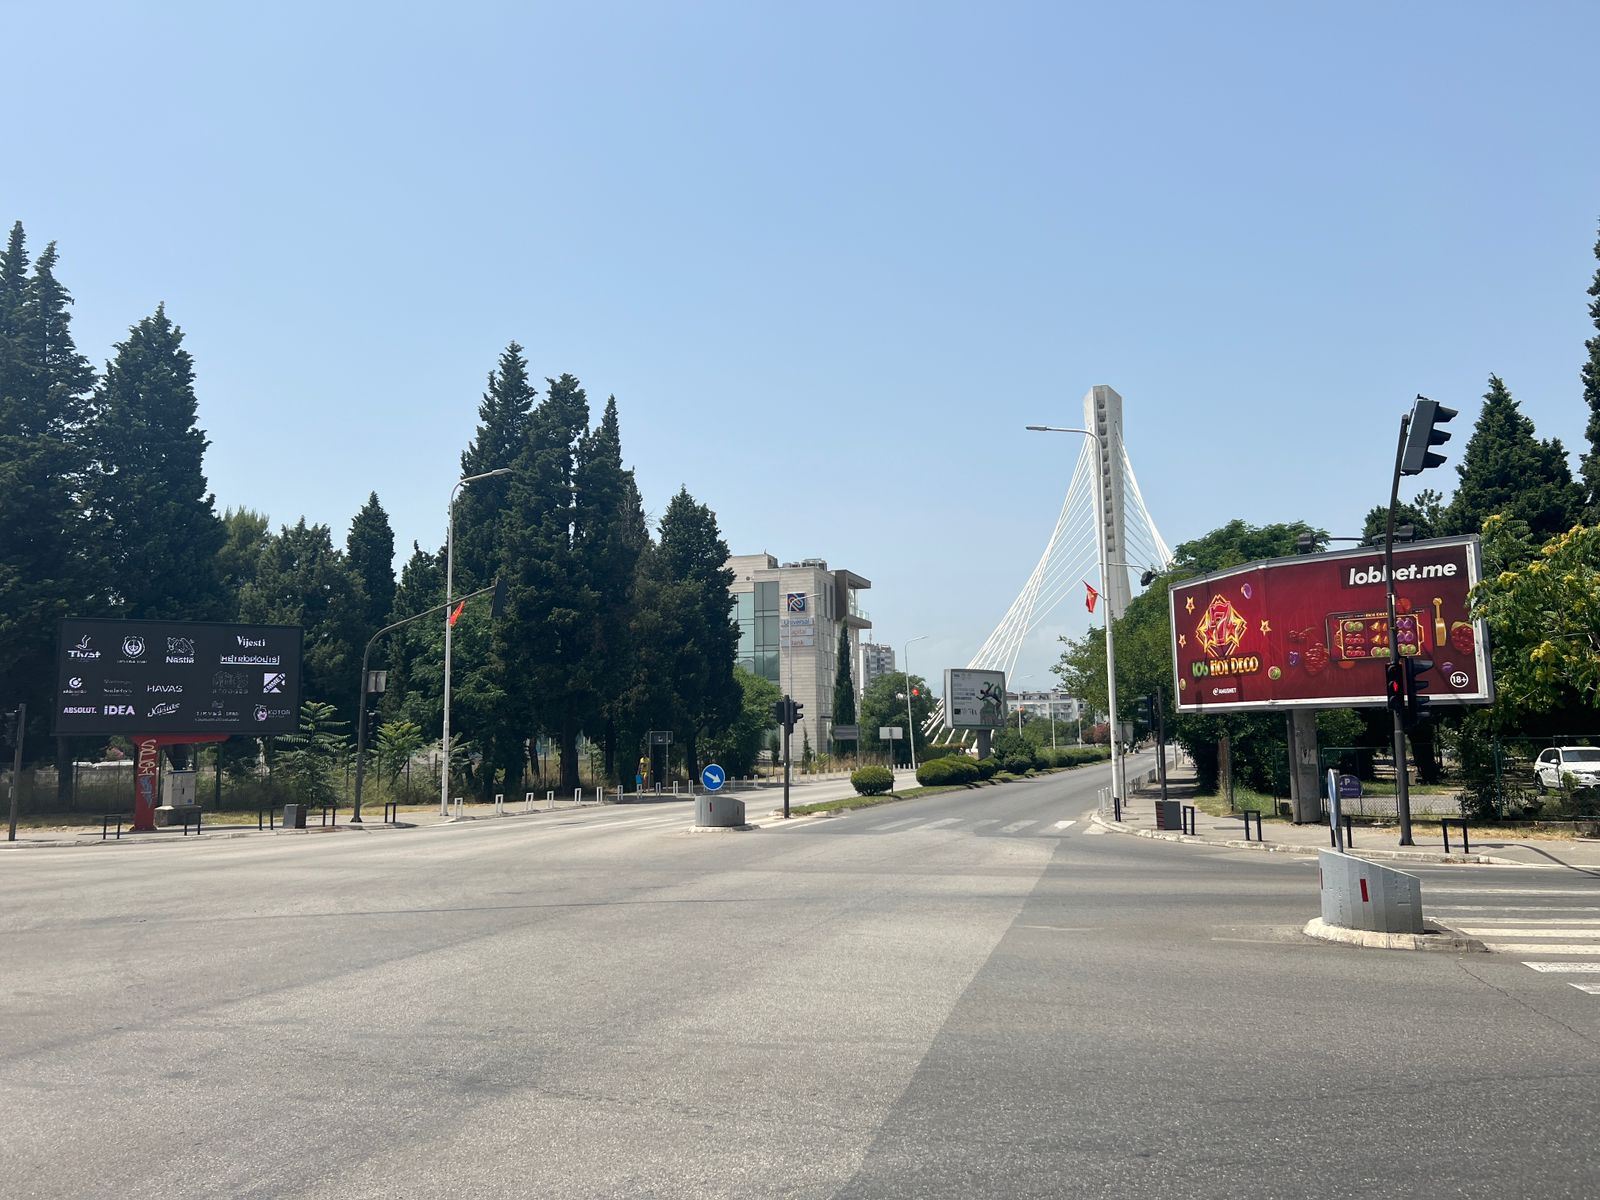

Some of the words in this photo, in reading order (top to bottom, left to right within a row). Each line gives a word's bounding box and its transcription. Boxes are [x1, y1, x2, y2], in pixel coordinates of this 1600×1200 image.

[236, 635, 266, 648] Vijesti
[221, 654, 279, 664] METROPOLIS
[1210, 659, 1229, 676] HOT
[1231, 656, 1259, 674] DECO
[1452, 675, 1467, 683] 18+
[147, 685, 183, 693] HAVAS
